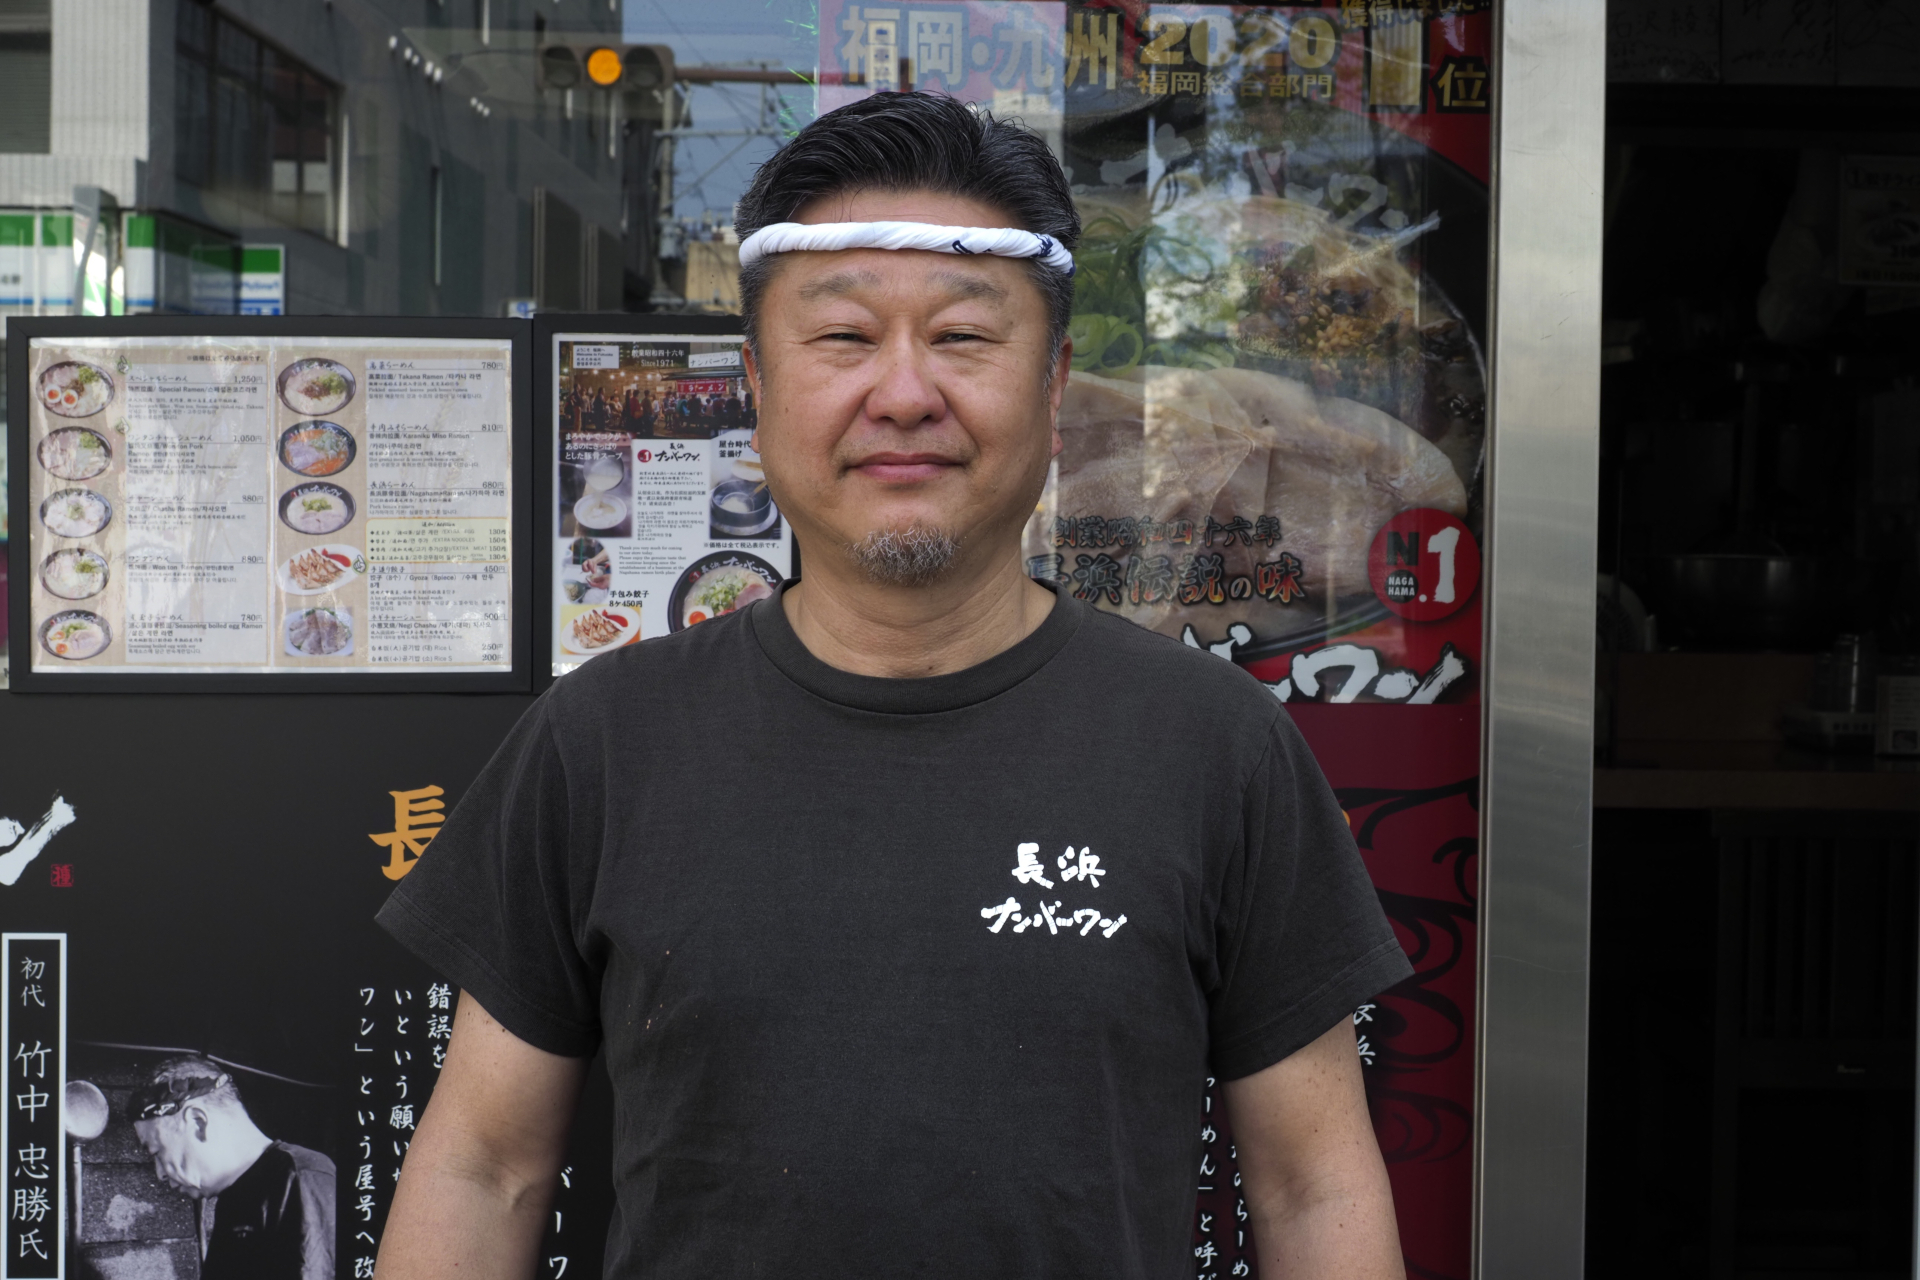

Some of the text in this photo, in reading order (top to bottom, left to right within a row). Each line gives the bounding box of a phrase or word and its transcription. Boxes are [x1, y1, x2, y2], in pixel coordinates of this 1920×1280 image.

[1140, 13, 1336, 69] 2020
[1137, 70, 1333, 98] 福岡総合部門
[690, 357, 738, 367] ナンバーワン
[565, 432, 622, 441] まろやかでコクが
[565, 442, 617, 450] あるのにさっぱり
[719, 440, 751, 448] 屋台時代
[565, 452, 623, 460] とした豚骨スープ
[654, 450, 700, 462] ナンバーワン
[1050, 516, 1282, 548] 創業昭和四十六年
[722, 556, 777, 583] ナンバーワン
[1388, 576, 1415, 587] NAGA
[609, 590, 650, 598] 手包み餃子
[1387, 587, 1416, 597] HAMA
[1011, 842, 1106, 889] 長浜
[980, 896, 1128, 938] ナンバーワン
[12, 956, 52, 1261] 初代 竹中忠勝氏
